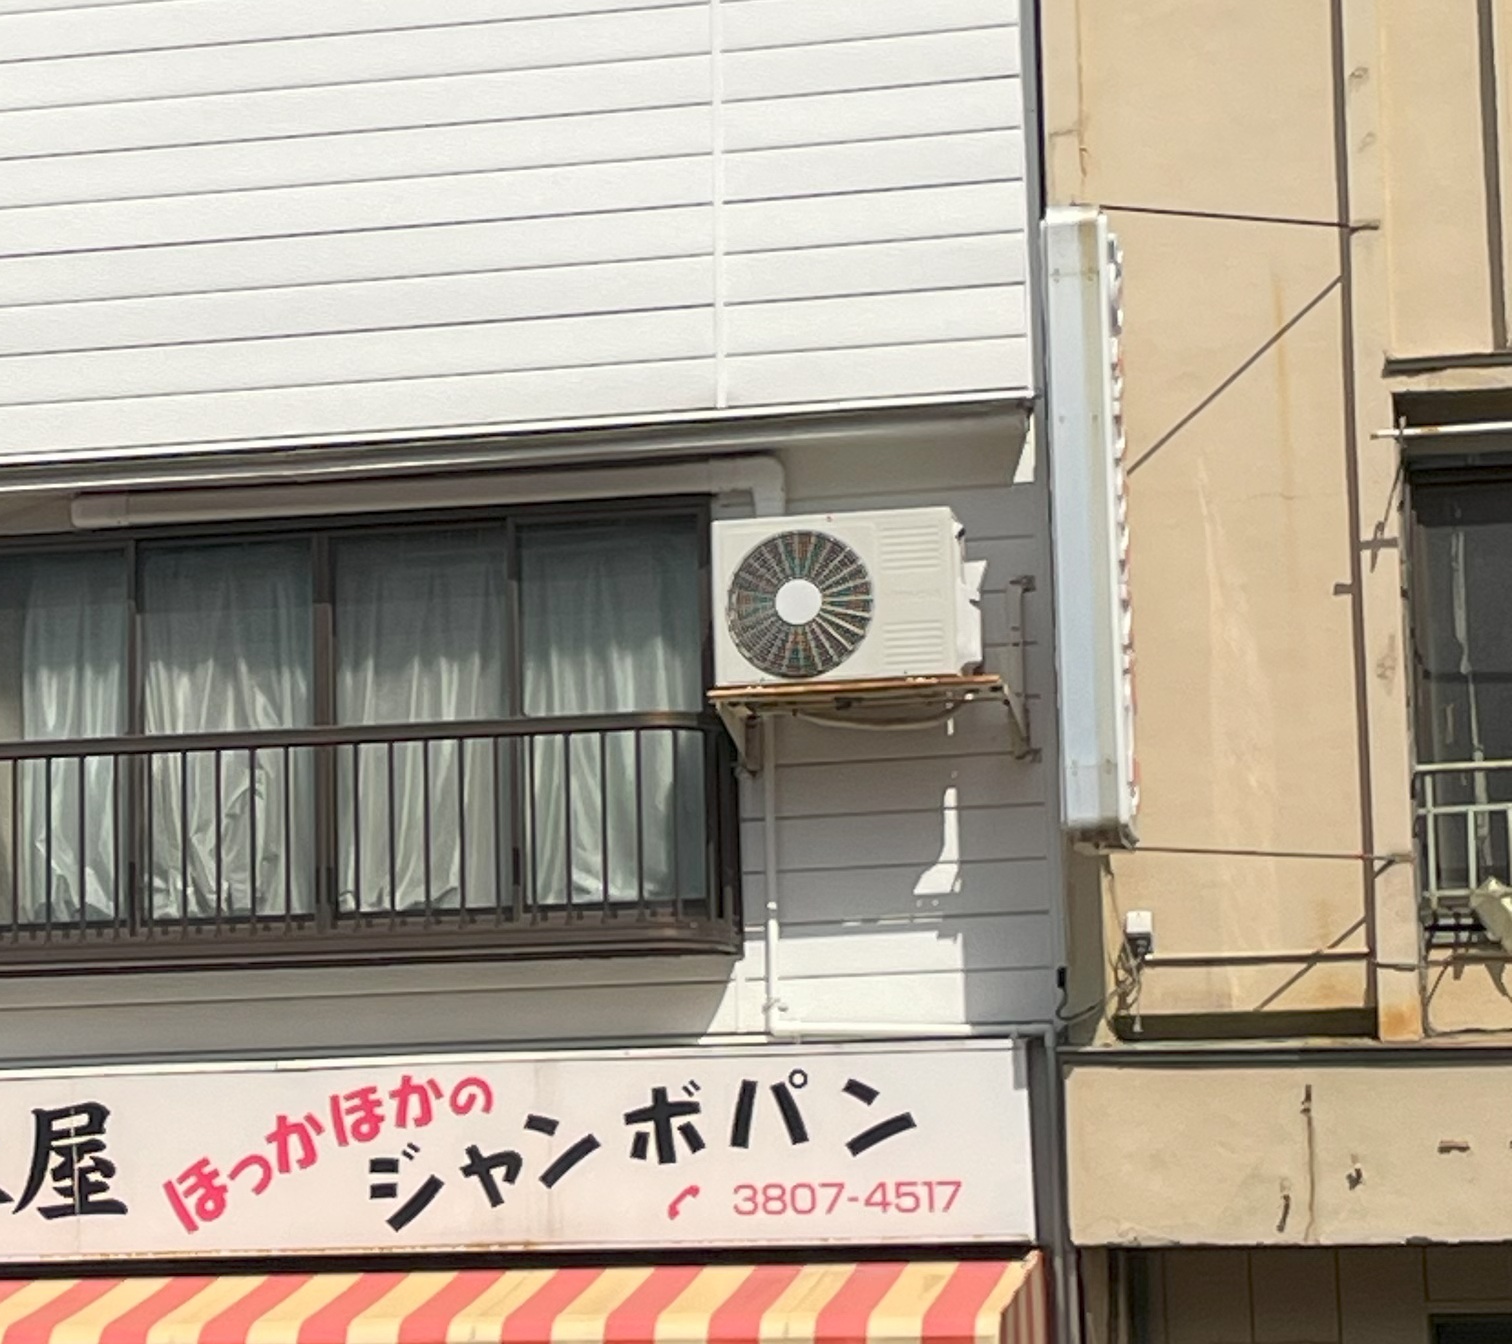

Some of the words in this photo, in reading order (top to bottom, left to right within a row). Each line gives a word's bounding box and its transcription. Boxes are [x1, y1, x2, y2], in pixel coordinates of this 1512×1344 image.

[162, 1073, 496, 1235] ほっかほかの
[369, 1069, 917, 1232] ジャンボパン
[732, 1179, 963, 1216] 3807-4517
